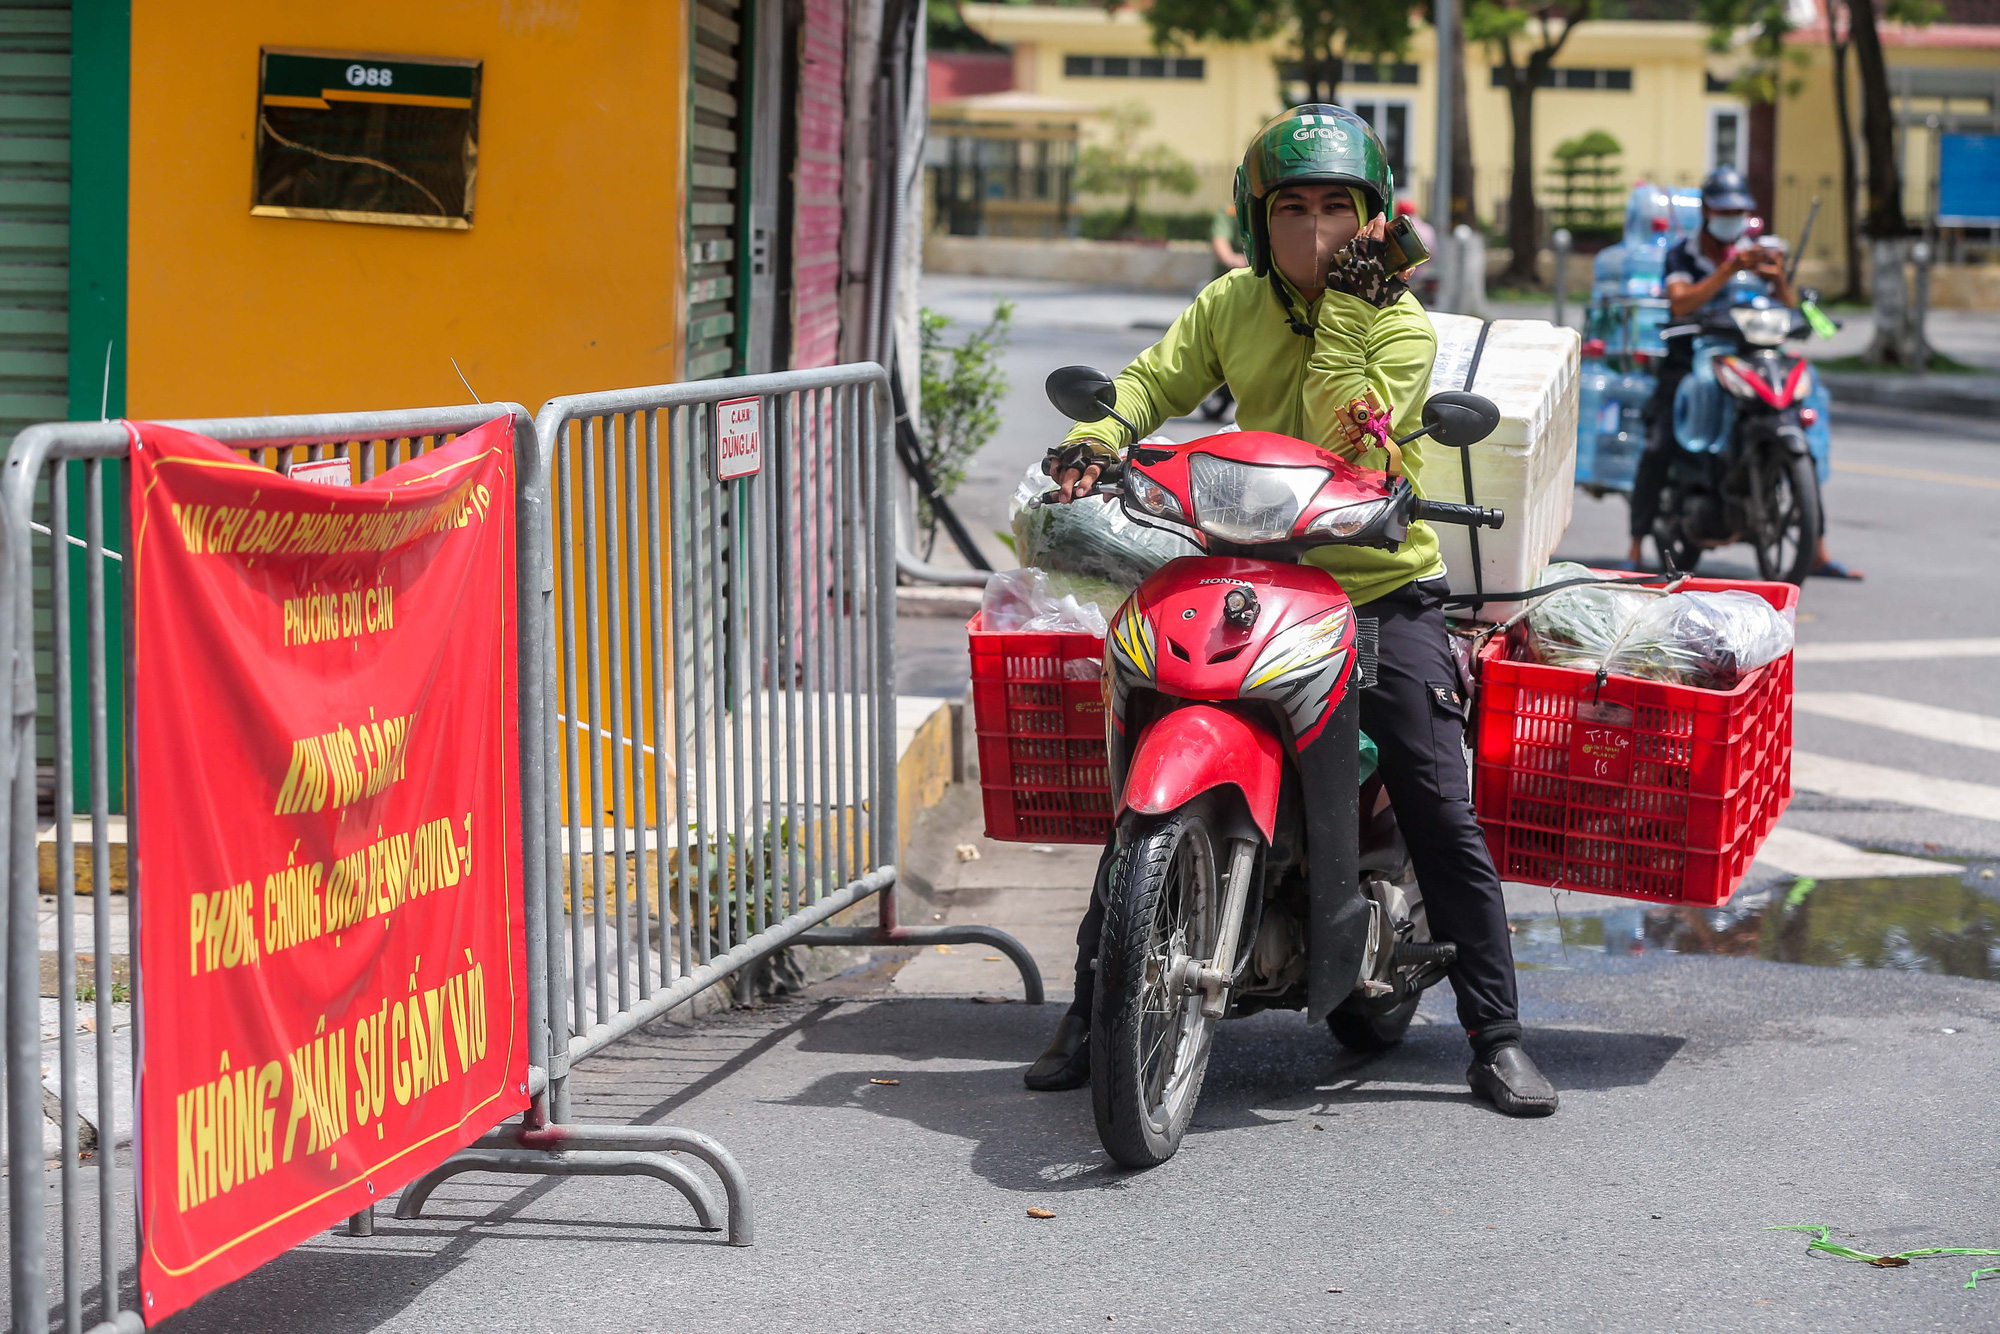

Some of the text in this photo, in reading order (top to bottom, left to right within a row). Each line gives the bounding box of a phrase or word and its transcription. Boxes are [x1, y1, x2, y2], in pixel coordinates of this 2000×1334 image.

[345, 65, 393, 87] F88
[1293, 126, 1348, 142] Grab
[236, 509, 294, 568] ĐẠO
[1198, 577, 1255, 589] HONDA
[283, 582, 340, 648] PHƯỜNG
[321, 722, 364, 823] VỰC
[264, 838, 324, 955] CHỐNG
[325, 848, 367, 948] DỊCH
[177, 1049, 283, 1214] KHÔNG
[354, 997, 389, 1141] SỰ
